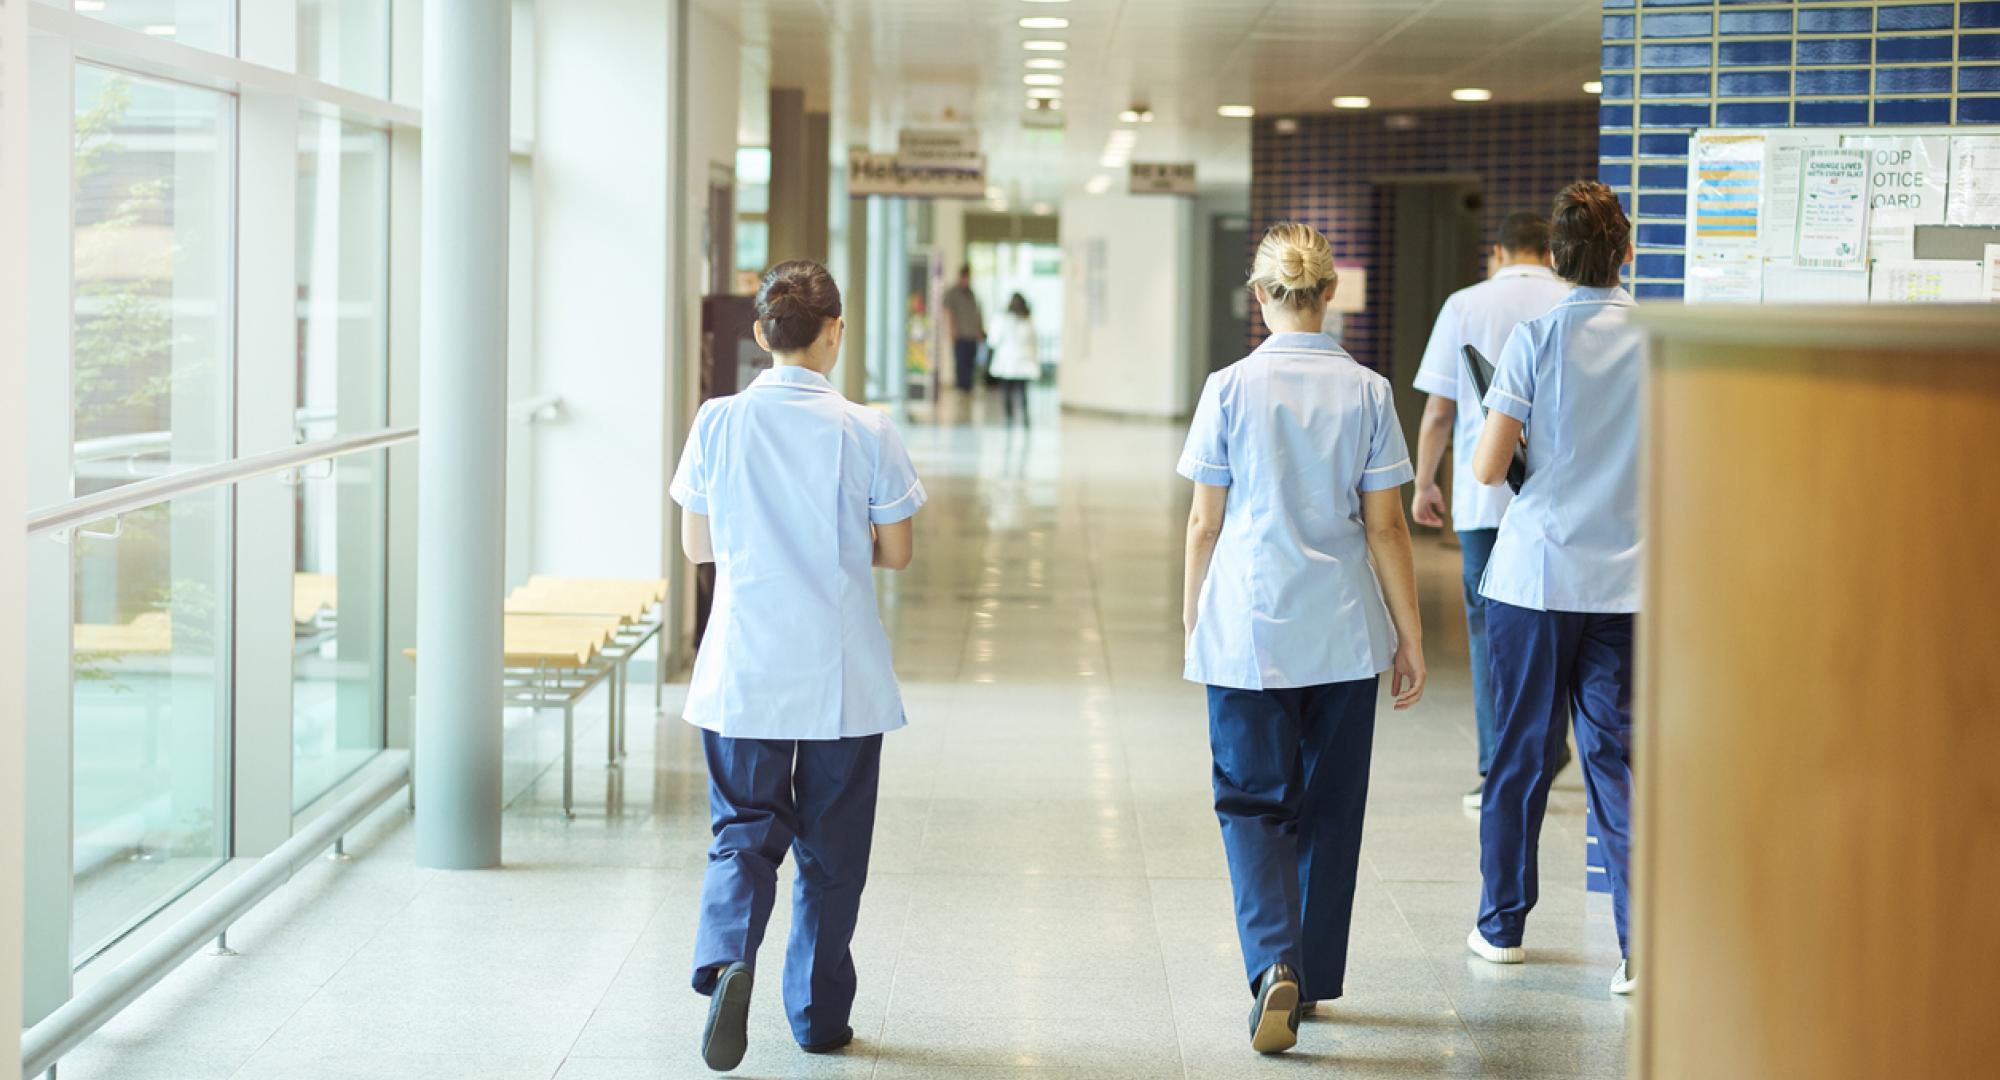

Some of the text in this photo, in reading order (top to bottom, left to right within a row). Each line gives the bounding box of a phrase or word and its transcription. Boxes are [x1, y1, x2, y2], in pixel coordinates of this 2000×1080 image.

[1876, 150, 1912, 166] ODP
[1873, 172, 1924, 188] OTICE
[1873, 194, 1921, 209] OARD
